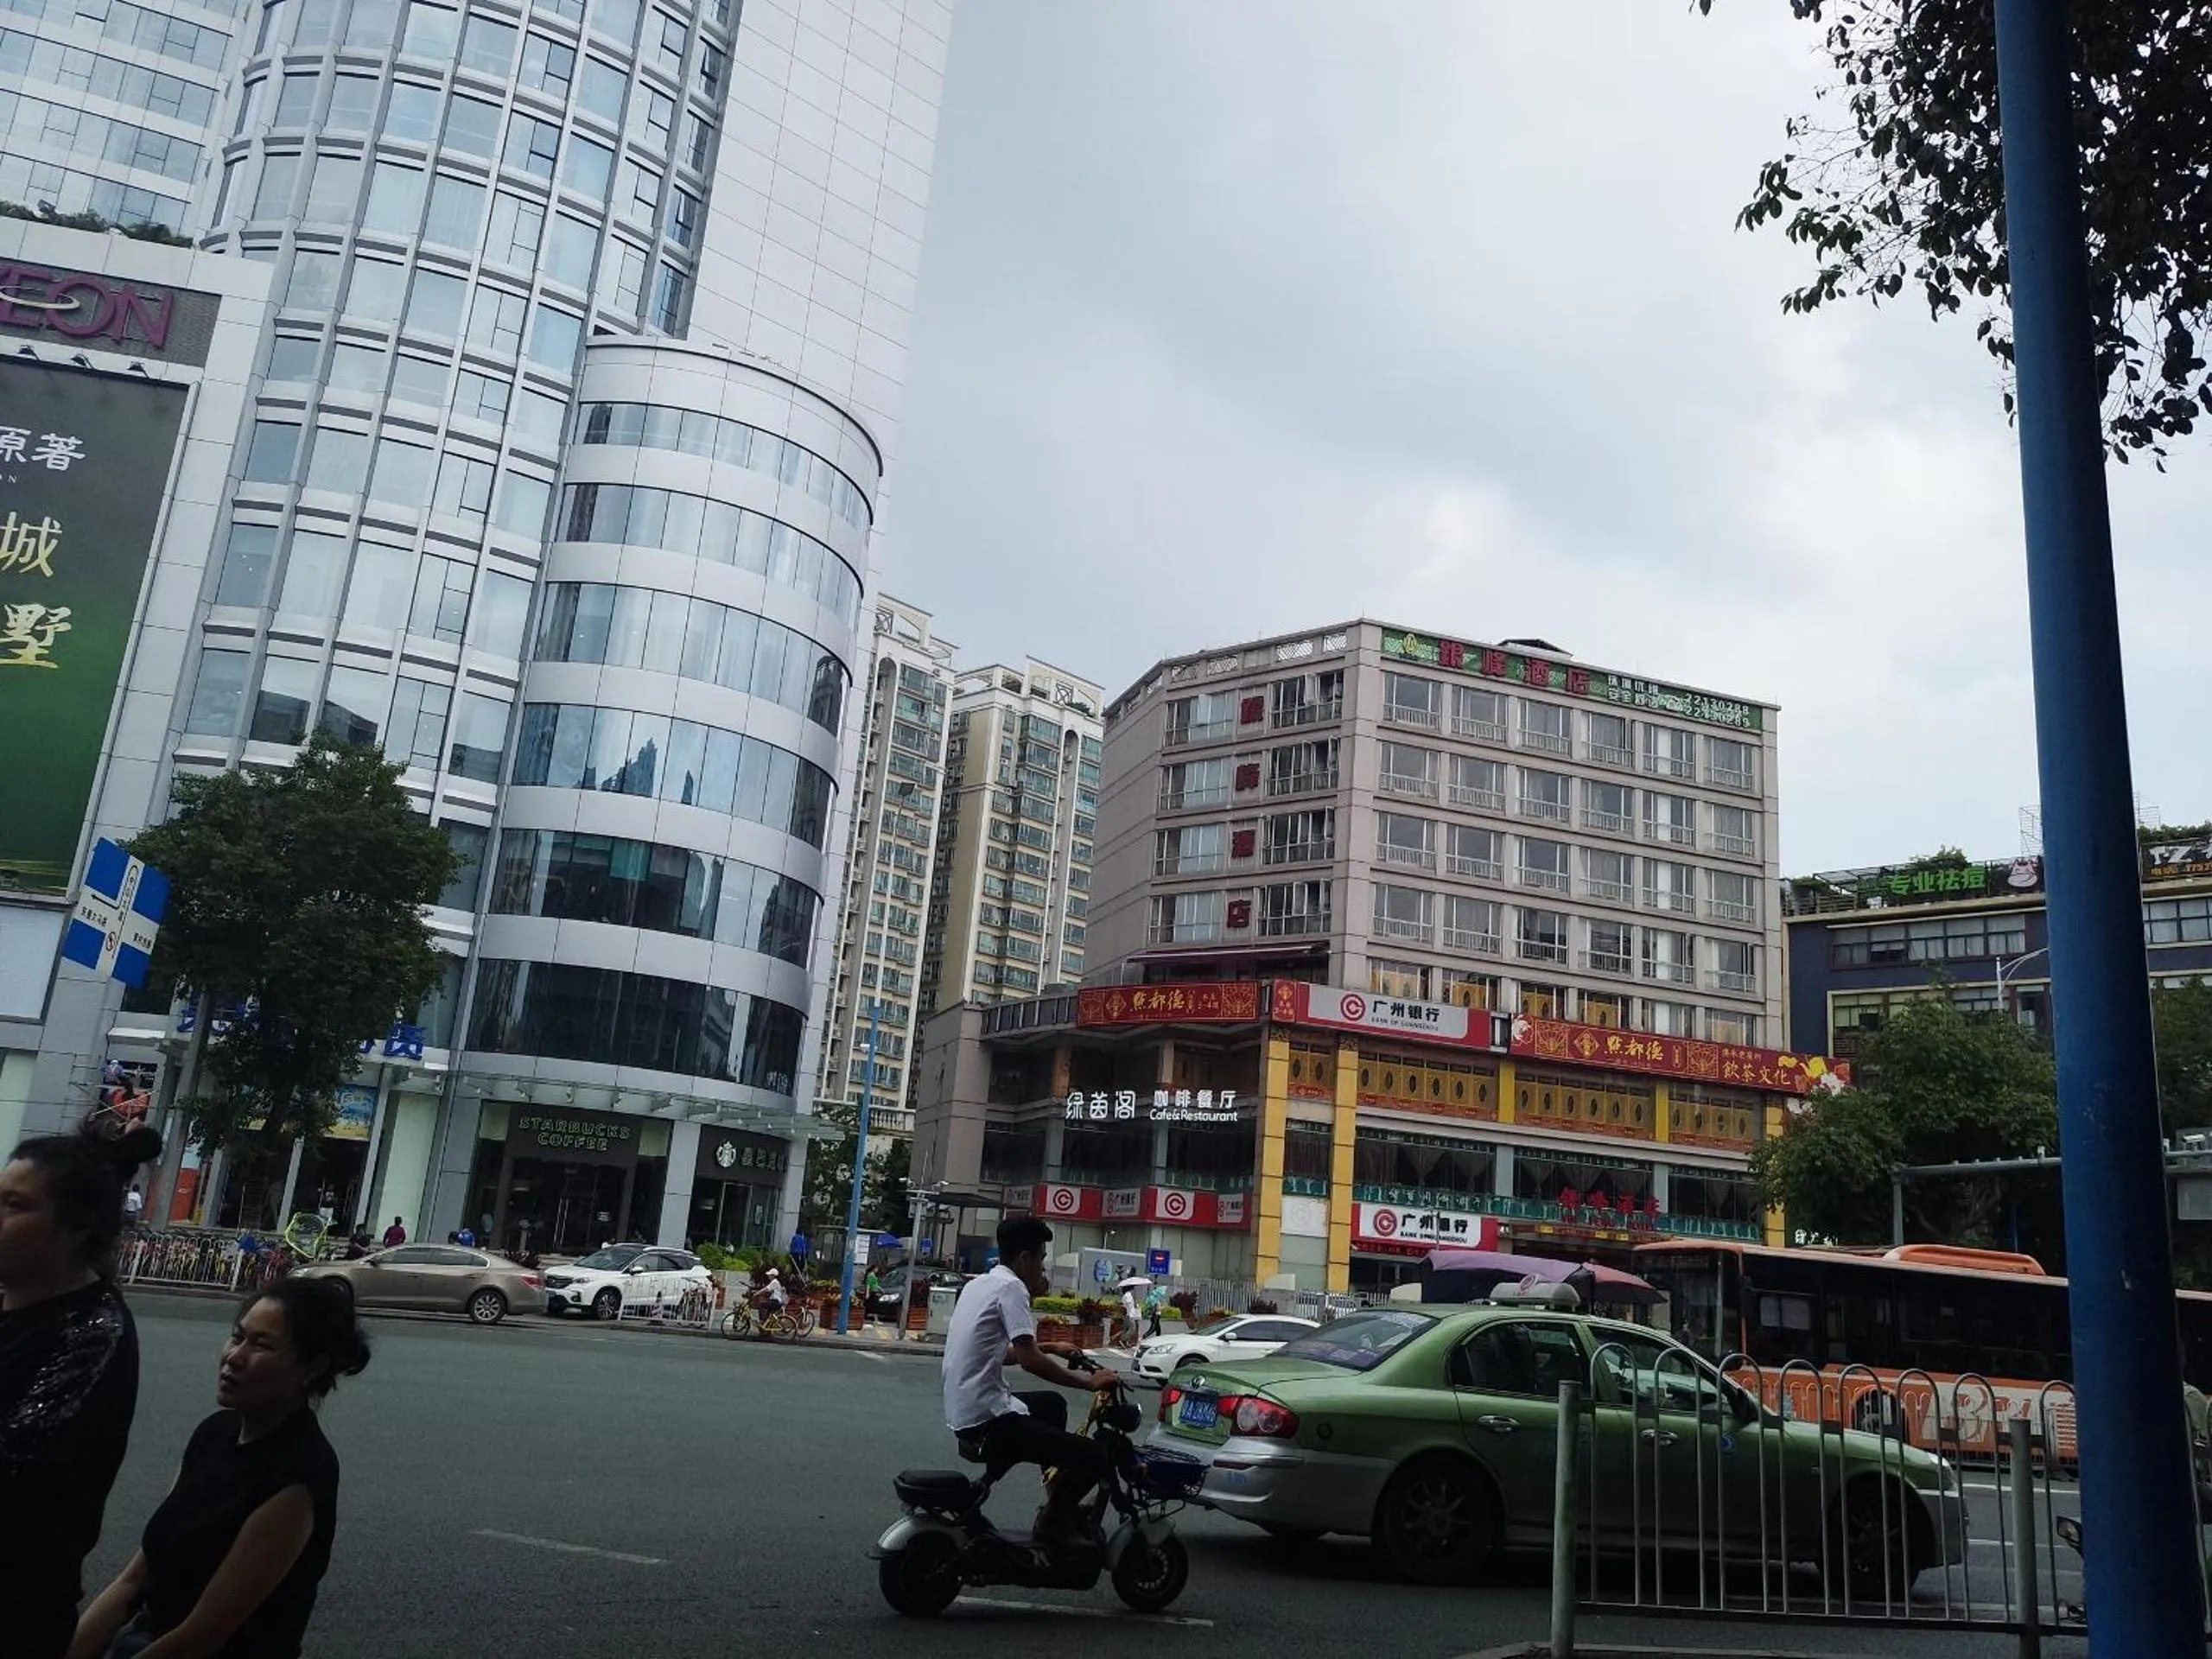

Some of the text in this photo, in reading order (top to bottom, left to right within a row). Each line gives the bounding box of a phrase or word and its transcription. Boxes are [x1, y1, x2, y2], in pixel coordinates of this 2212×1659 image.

[1889, 867, 1986, 895] 专业祛痘
[1372, 1000, 1440, 1022] 广州银行
[1721, 1059, 1791, 1084] 飲茶文化
[1065, 1089, 1236, 1121] 绿茵阁 咖啡餐厅
[518, 1116, 631, 1140] STARBUCKS
[537, 1131, 608, 1152] COFFEE
